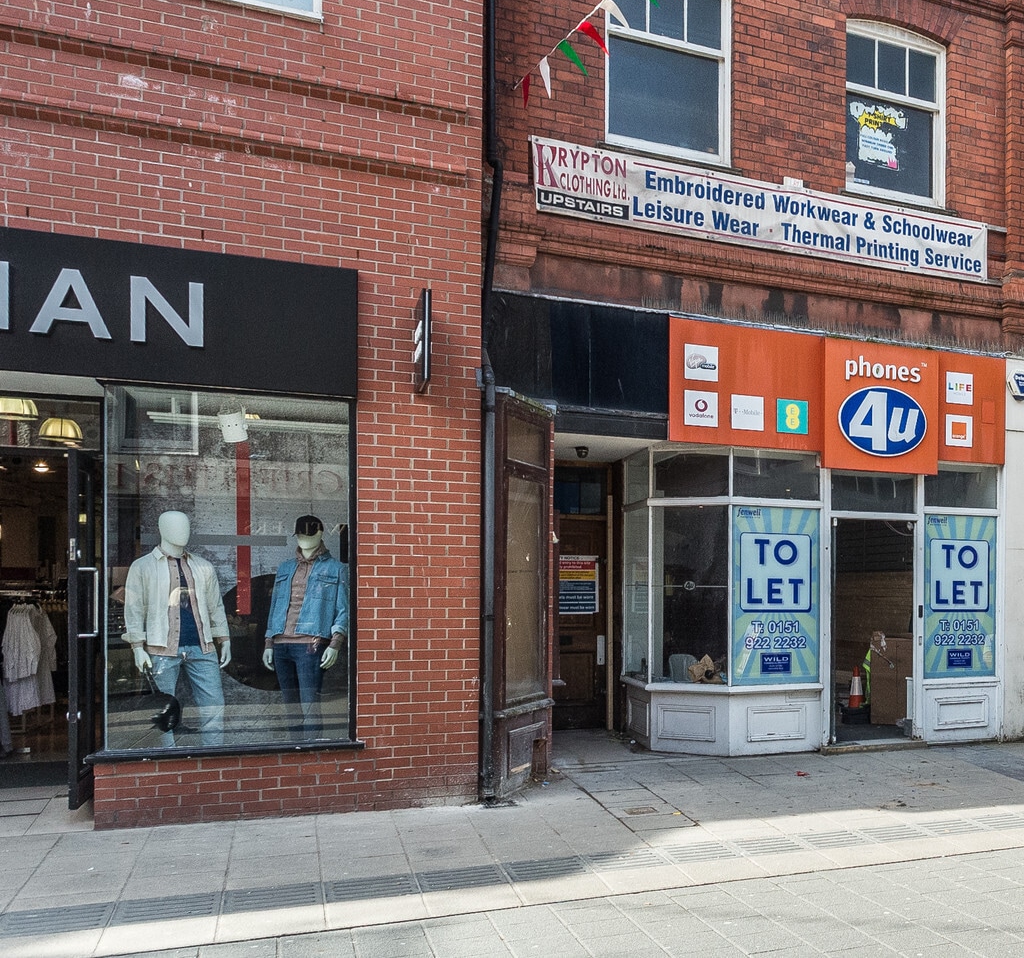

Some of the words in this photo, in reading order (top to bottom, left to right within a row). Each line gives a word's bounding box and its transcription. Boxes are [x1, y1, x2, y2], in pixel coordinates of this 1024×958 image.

[534, 143, 627, 188] KRYPTON
[560, 172, 612, 200] CLOTHING
[612, 185, 630, 201] Ltd.
[540, 192, 624, 217] UPSTAIRS
[645, 170, 765, 210] Embroidered
[773, 193, 858, 227] Workwear
[864, 212, 876, 230] &
[882, 214, 973, 248] Schoolwear
[632, 196, 704, 227] Leisure
[712, 210, 760, 237] Wear
[781, 222, 850, 252] Thermal
[856, 236, 919, 267] Printing
[924, 247, 982, 273] Service
[0, 261, 204, 348] AN
[845, 354, 921, 383] phones
[948, 382, 972, 392] LIFE
[848, 390, 920, 452] 4u
[754, 538, 798, 566] TO
[941, 544, 978, 570] TO
[746, 578, 804, 604] LET
[935, 580, 983, 605] LET
[751, 620, 764, 634] T:
[768, 621, 800, 634] 0151
[940, 620, 952, 632] T:
[952, 620, 980, 632] 0151
[745, 636, 771, 650] 922
[774, 637, 806, 649] 2232
[934, 634, 956, 646] 922
[958, 634, 986, 646] 2232
